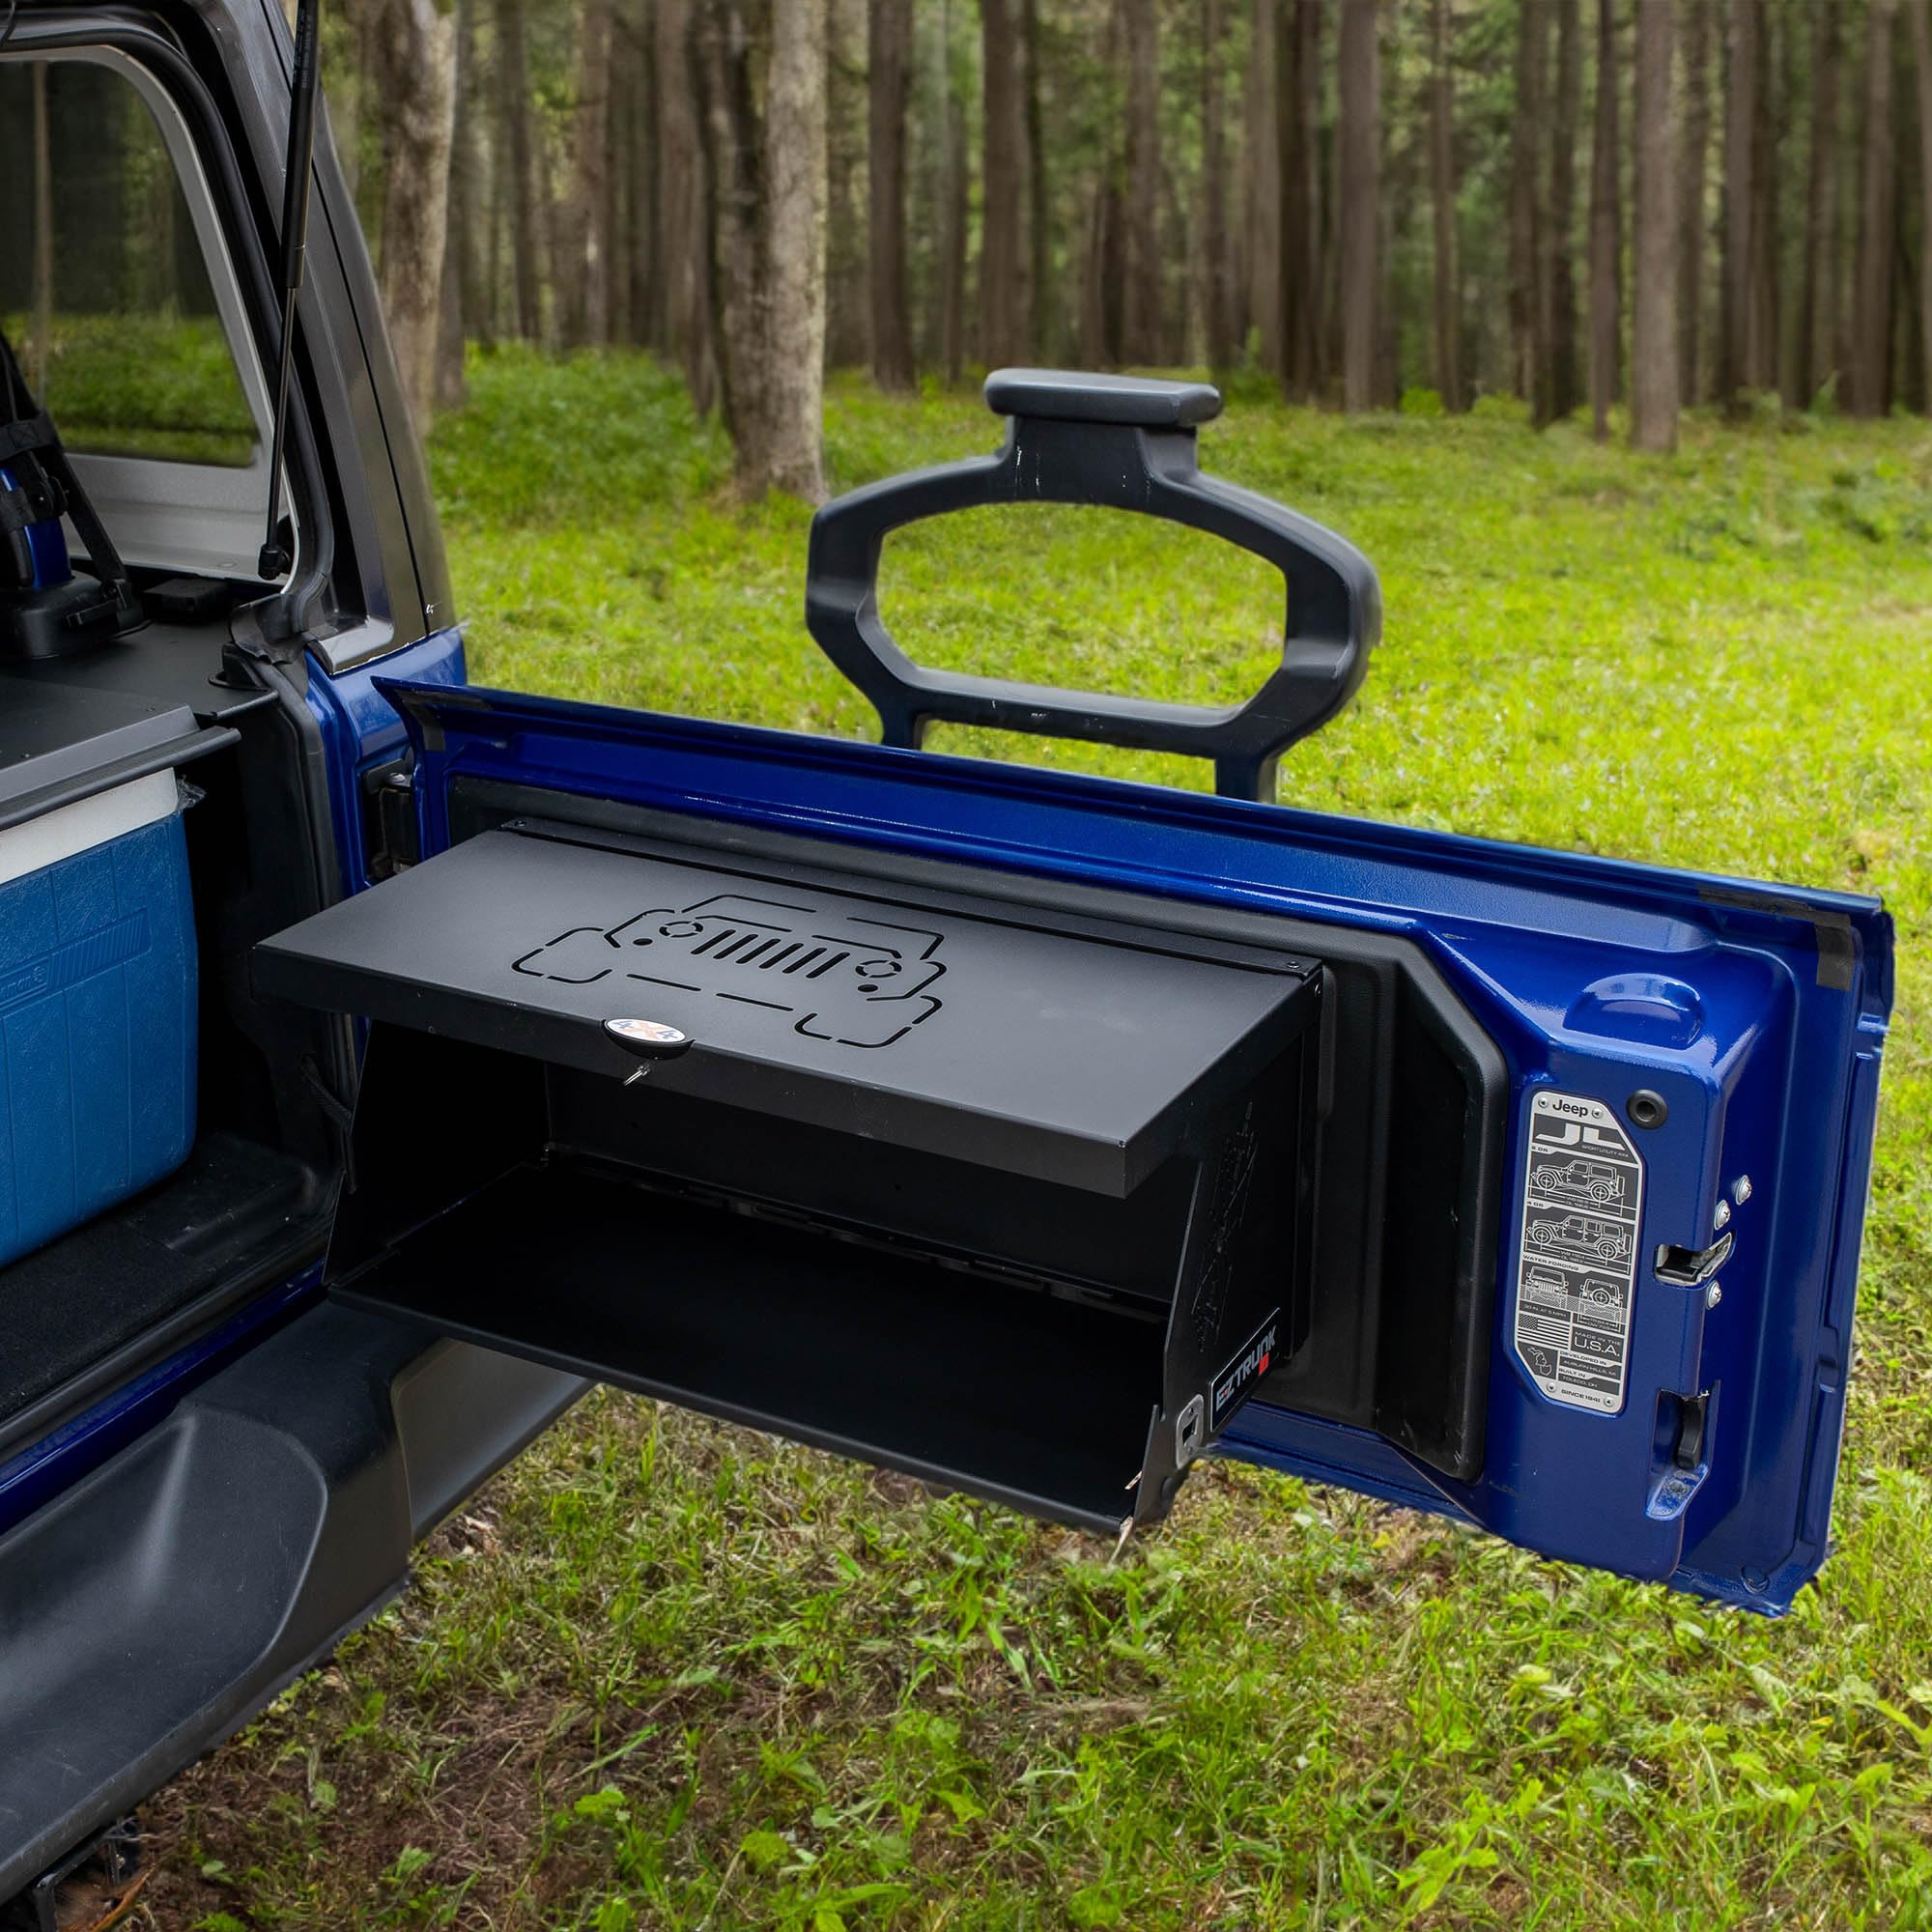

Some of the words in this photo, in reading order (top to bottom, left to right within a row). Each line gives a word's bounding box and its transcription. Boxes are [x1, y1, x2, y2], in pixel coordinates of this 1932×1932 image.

[1552, 1099, 1589, 1118] Jeep
[1536, 1122, 1626, 1151] JL
[1522, 1254, 1548, 1264] WATER
[1548, 1260, 1579, 1271] FORDING
[1575, 1331, 1597, 1341] MADE
[1574, 1336, 1621, 1357] U.S.A.
[1559, 1350, 1599, 1364] DEVELOPED
[1558, 1367, 1577, 1376] BUILT
[1561, 1389, 1585, 1400] SINCE
